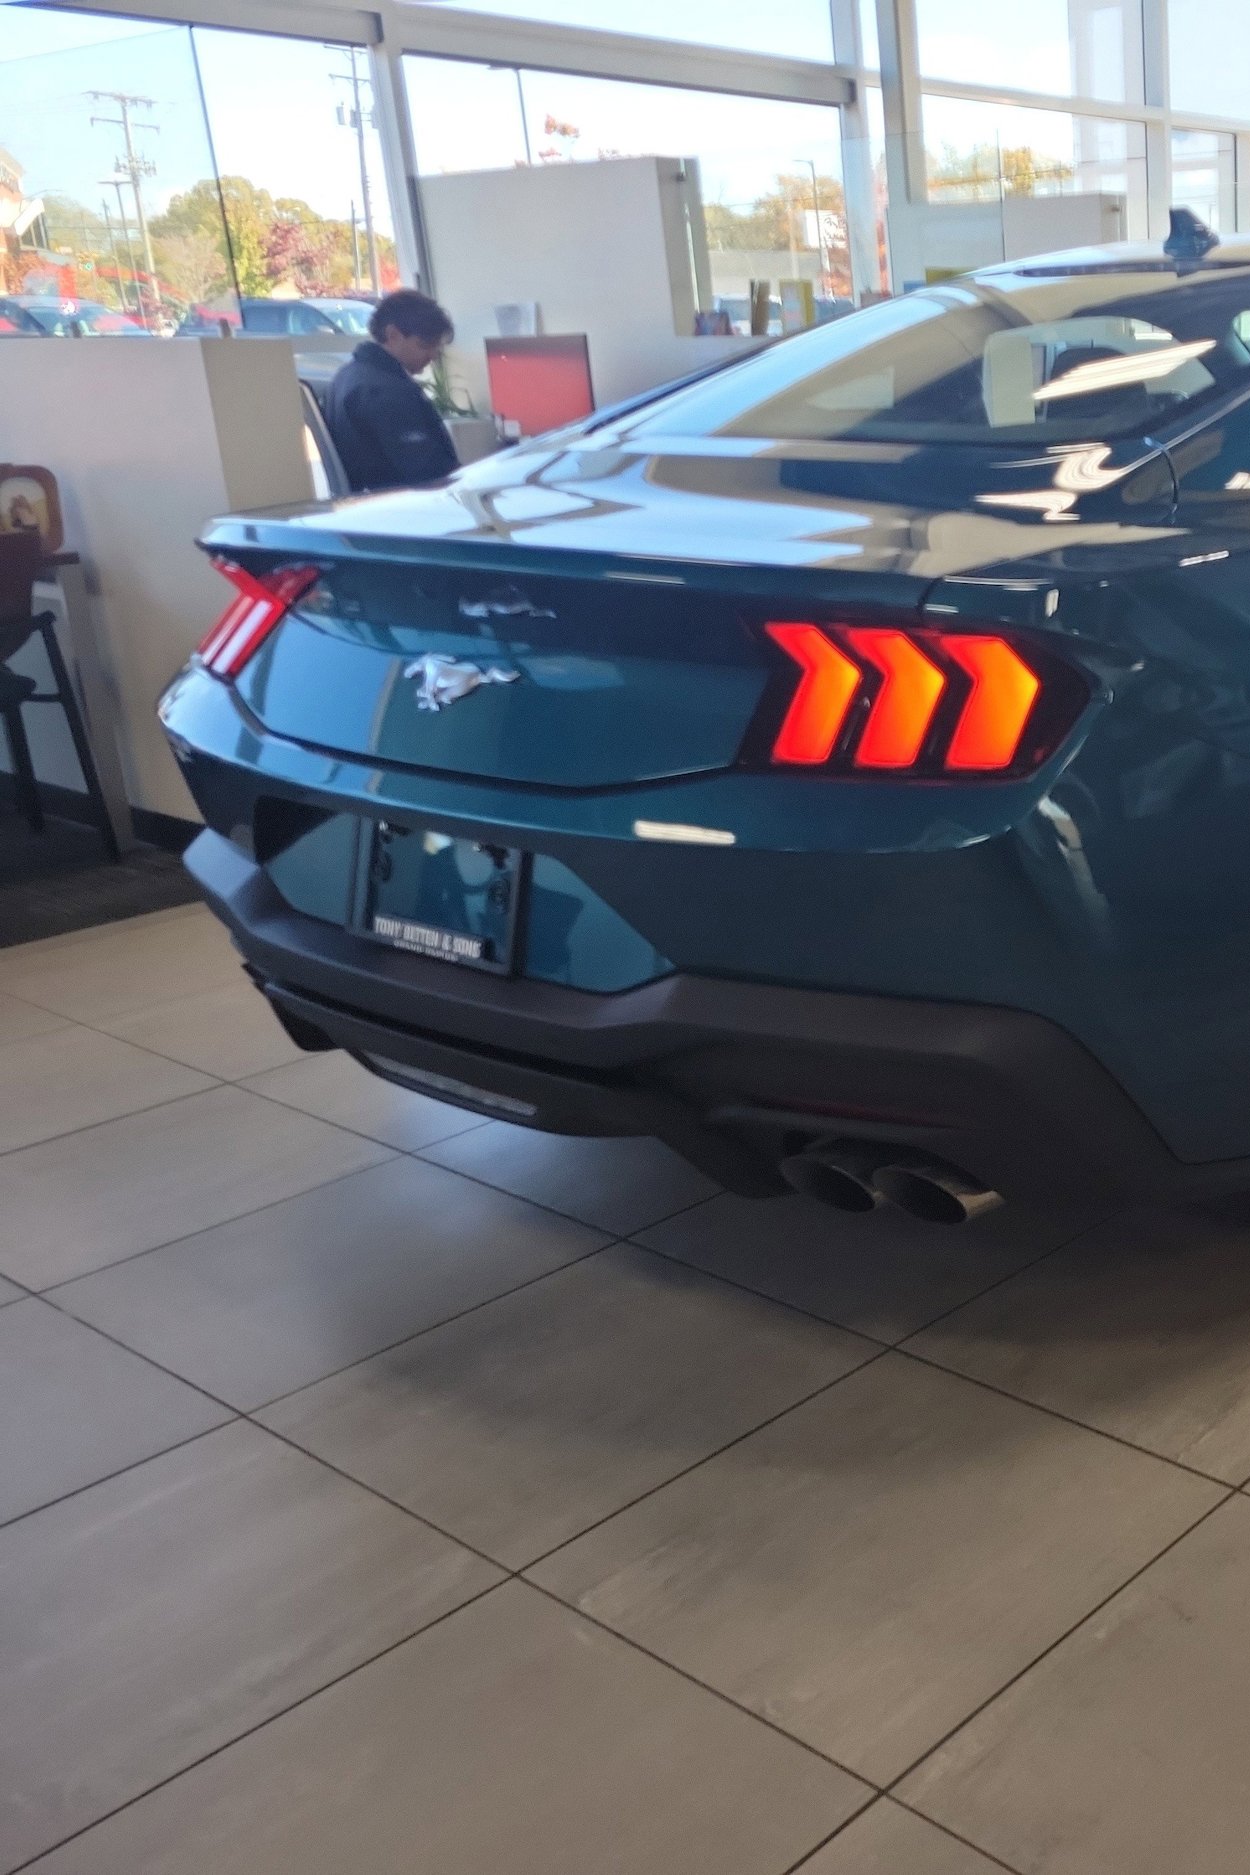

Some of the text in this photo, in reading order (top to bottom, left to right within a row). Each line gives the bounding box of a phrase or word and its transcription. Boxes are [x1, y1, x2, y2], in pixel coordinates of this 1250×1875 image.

[375, 916, 401, 938] TONY
[442, 933, 451, 951] &
[453, 936, 481, 958] SONS
